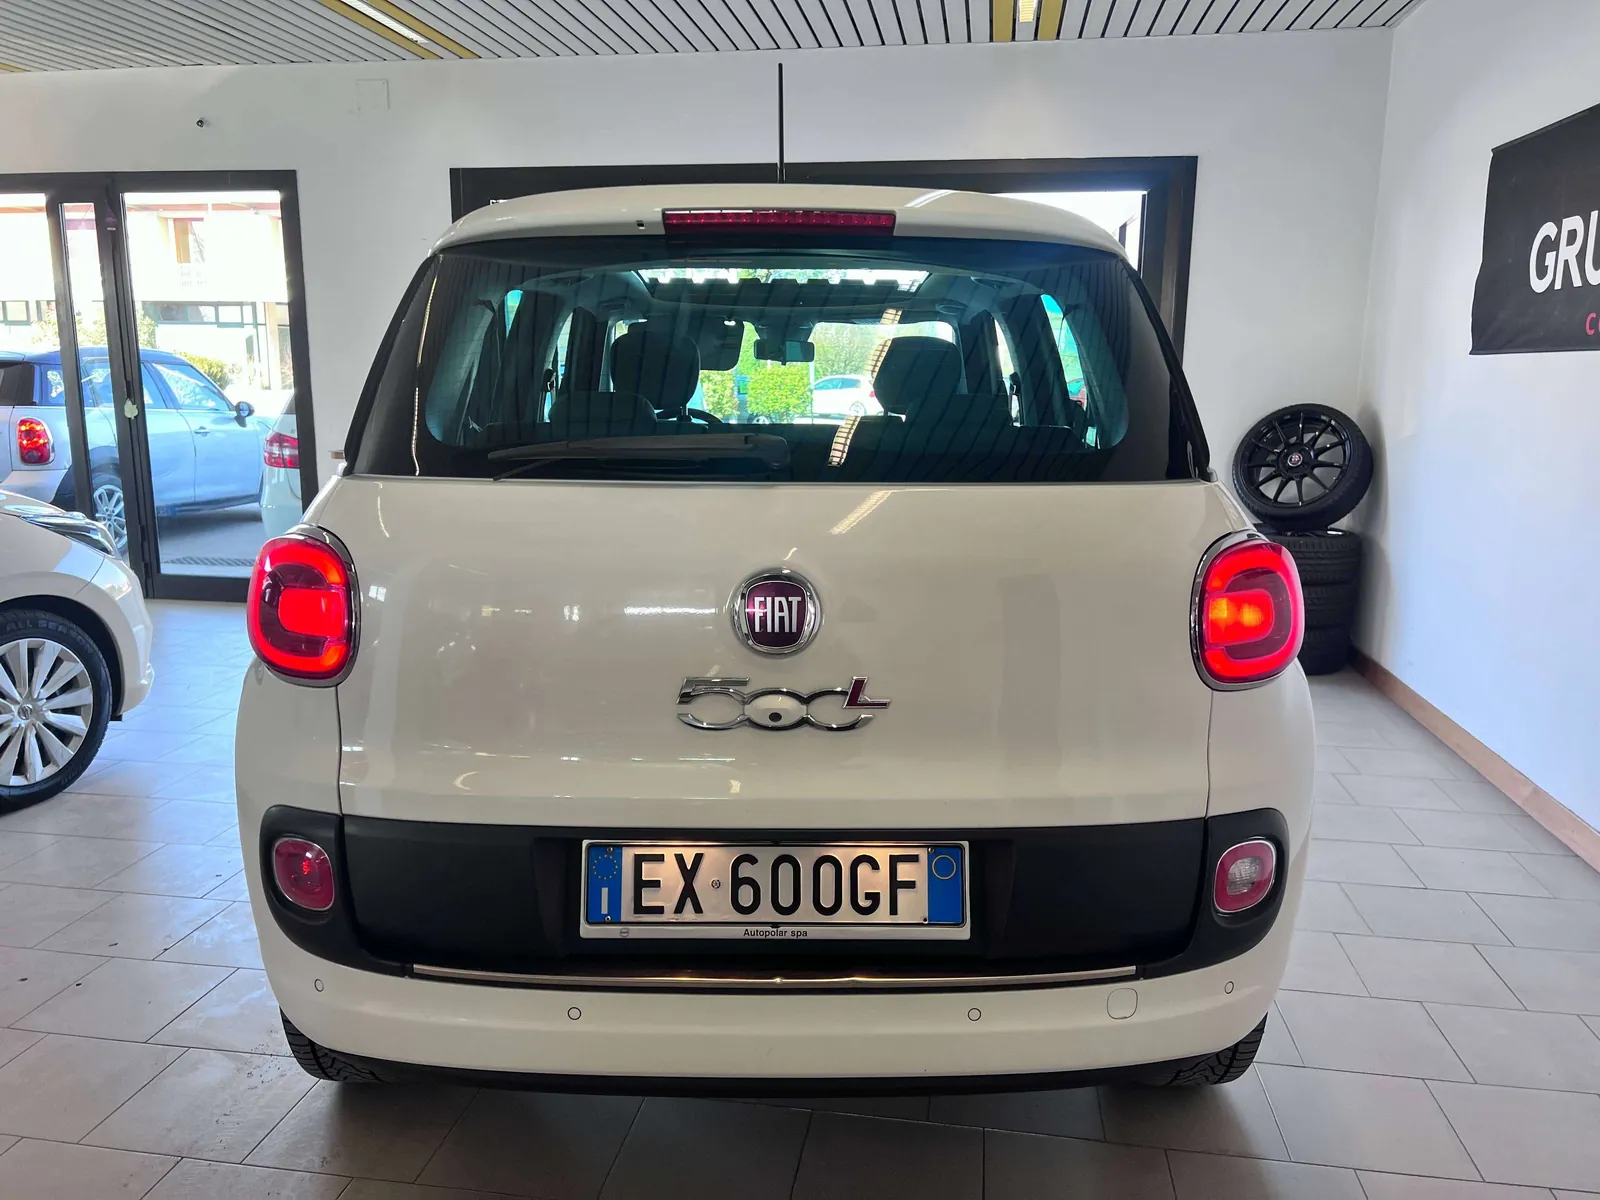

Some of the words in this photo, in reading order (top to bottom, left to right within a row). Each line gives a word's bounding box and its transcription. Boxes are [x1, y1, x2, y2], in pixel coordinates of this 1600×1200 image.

[753, 596, 801, 633] FIAT
[633, 852, 704, 915] EX
[729, 853, 920, 916] 600GF
[743, 928, 788, 938] Autopolar
[790, 930, 808, 938] spa
